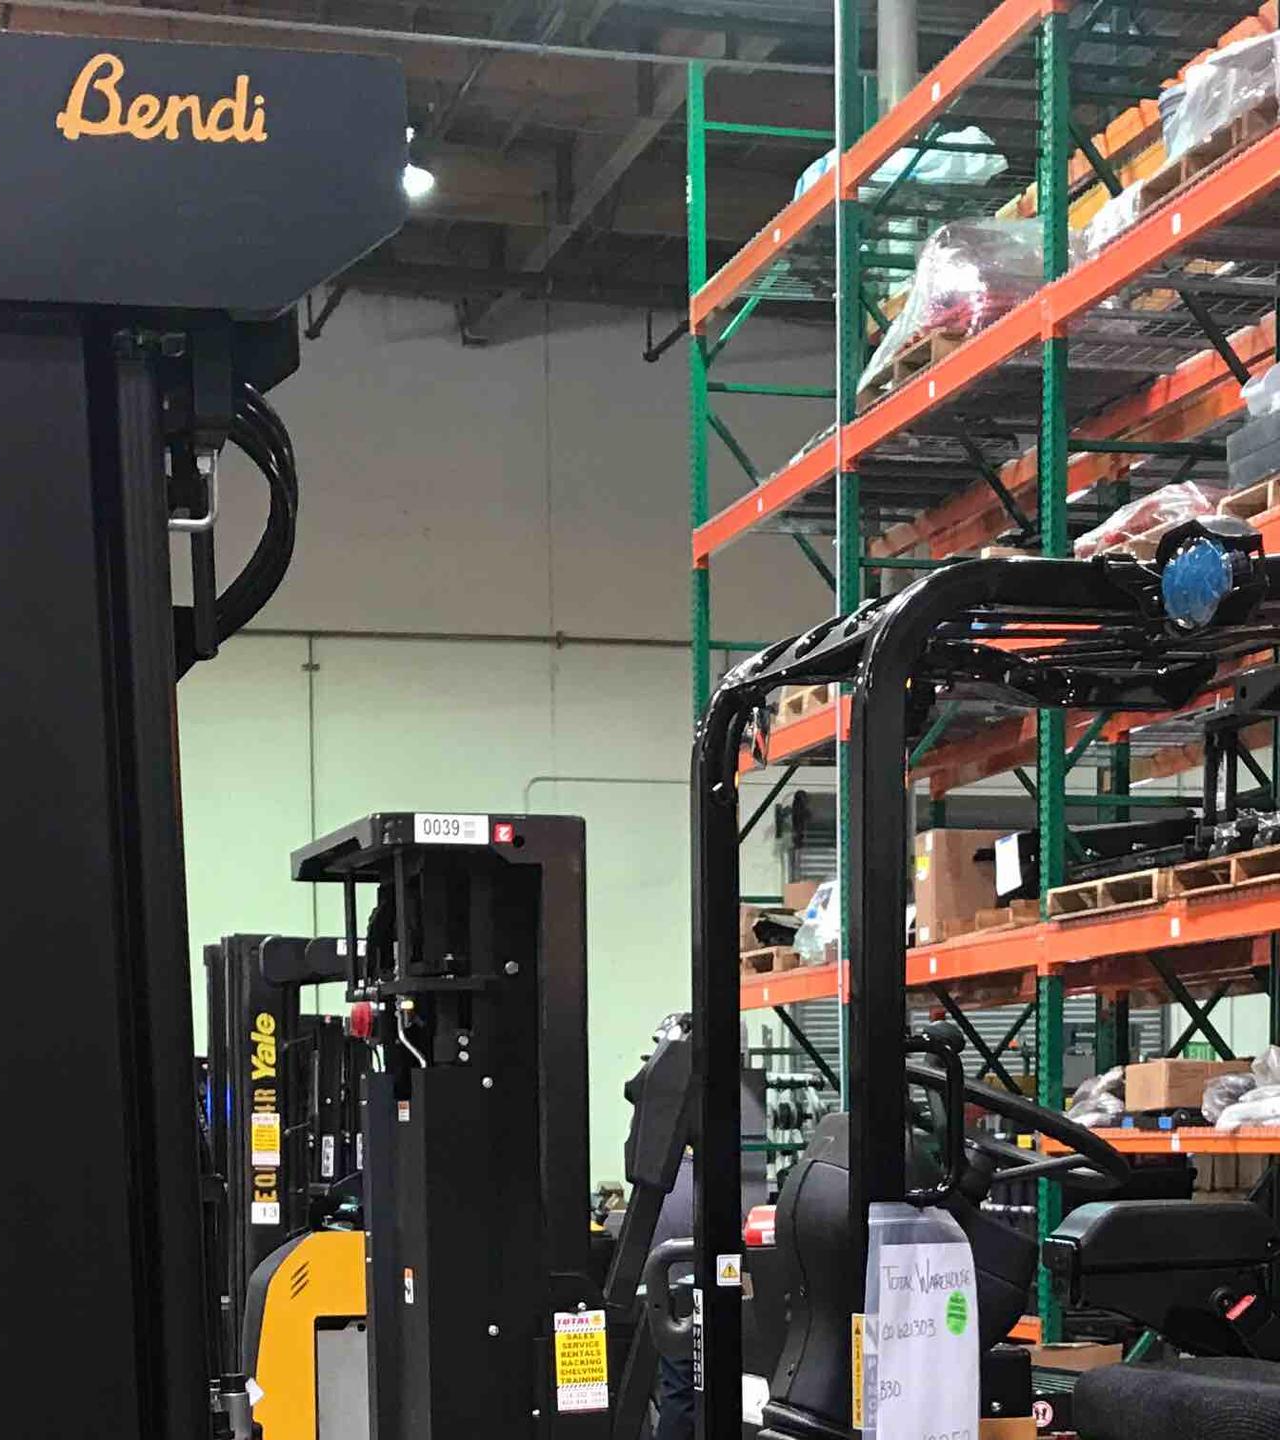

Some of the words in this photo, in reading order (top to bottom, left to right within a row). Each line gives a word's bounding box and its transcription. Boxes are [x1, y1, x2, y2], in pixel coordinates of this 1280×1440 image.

[56, 52, 269, 144] Bendi
[423, 818, 460, 836] 0039
[251, 1012, 277, 1081] Yale
[562, 1341, 600, 1350] SERVICE
[561, 1350, 602, 1359] RENTALS
[560, 1367, 604, 1377] SHELVING
[559, 1376, 605, 1386] TRAINING
